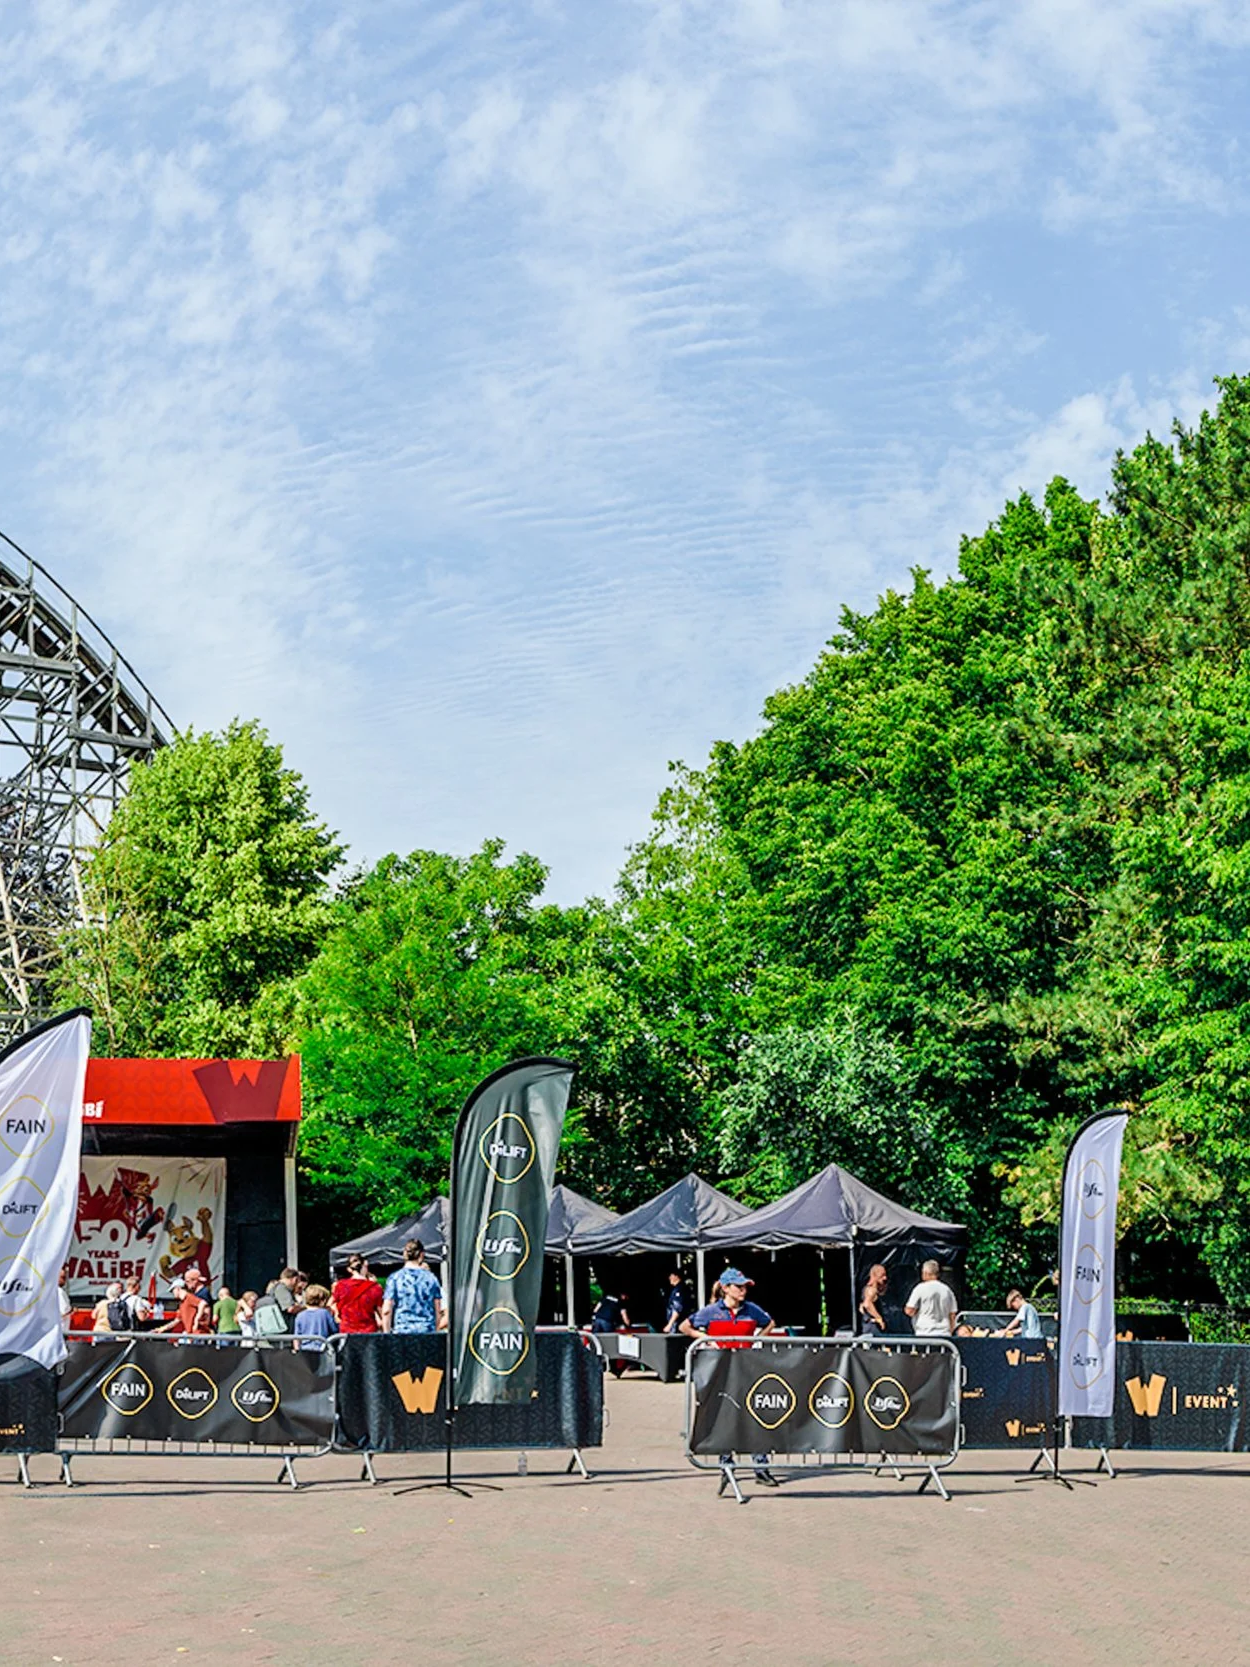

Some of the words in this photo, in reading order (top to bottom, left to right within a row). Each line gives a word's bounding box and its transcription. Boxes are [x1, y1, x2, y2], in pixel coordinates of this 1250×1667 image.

[6, 1119, 46, 1134] FAIN
[79, 1219, 128, 1246] 50
[479, 1333, 523, 1350] FAIN
[111, 1382, 146, 1397] FAIN
[754, 1394, 788, 1409] FAIN
[1185, 1395, 1228, 1408] EVENT
